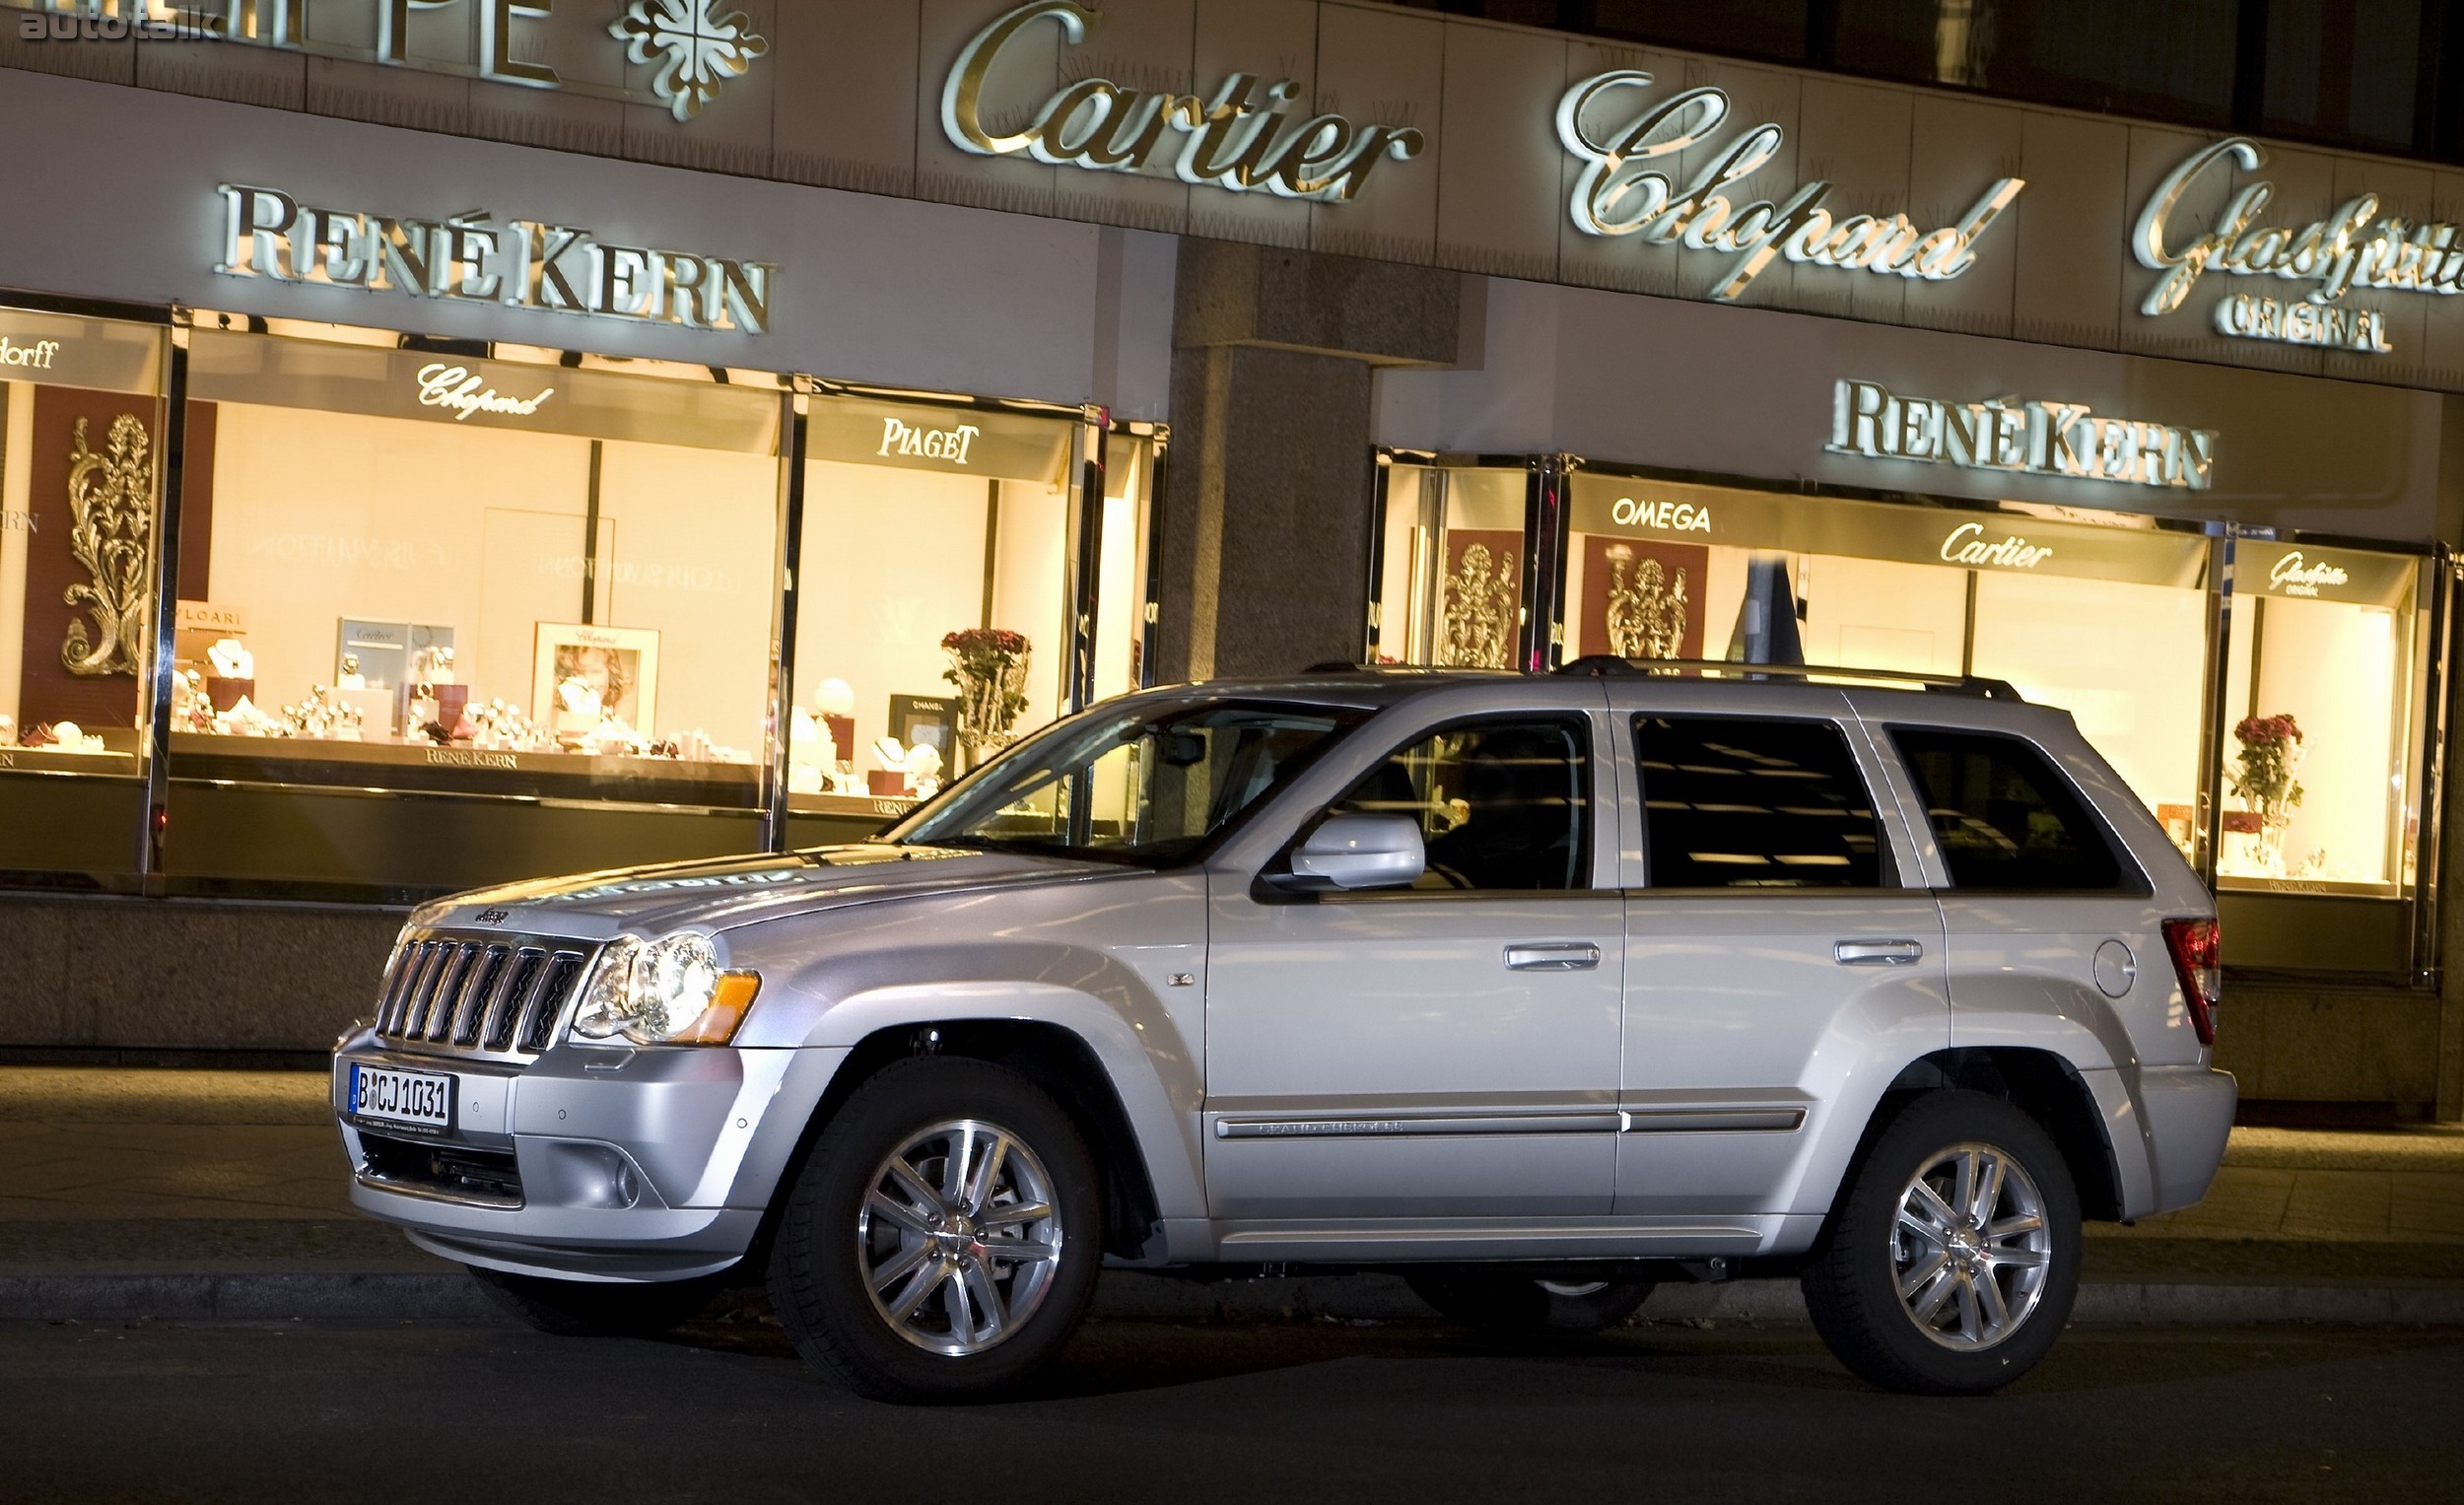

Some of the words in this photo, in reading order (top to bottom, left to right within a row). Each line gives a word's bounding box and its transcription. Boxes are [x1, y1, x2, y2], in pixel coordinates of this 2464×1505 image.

[941, 0, 1426, 203] Cartier
[1556, 69, 2026, 302] Chopard
[2132, 136, 2464, 316] Glashütt
[213, 182, 502, 306] RENÉ
[504, 220, 783, 336] KERN
[2214, 293, 2392, 352] ORIGINAL
[417, 363, 555, 421] Chopard
[876, 417, 980, 464] PIAGET
[1823, 378, 2026, 472] RENÉ
[2025, 399, 2220, 490] KERN
[1611, 497, 1711, 533] OMEGA
[1940, 521, 2053, 569] Cartier
[912, 700, 944, 712] CHANEL
[473, 750, 517, 769] KERN
[358, 1072, 369, 1109] B
